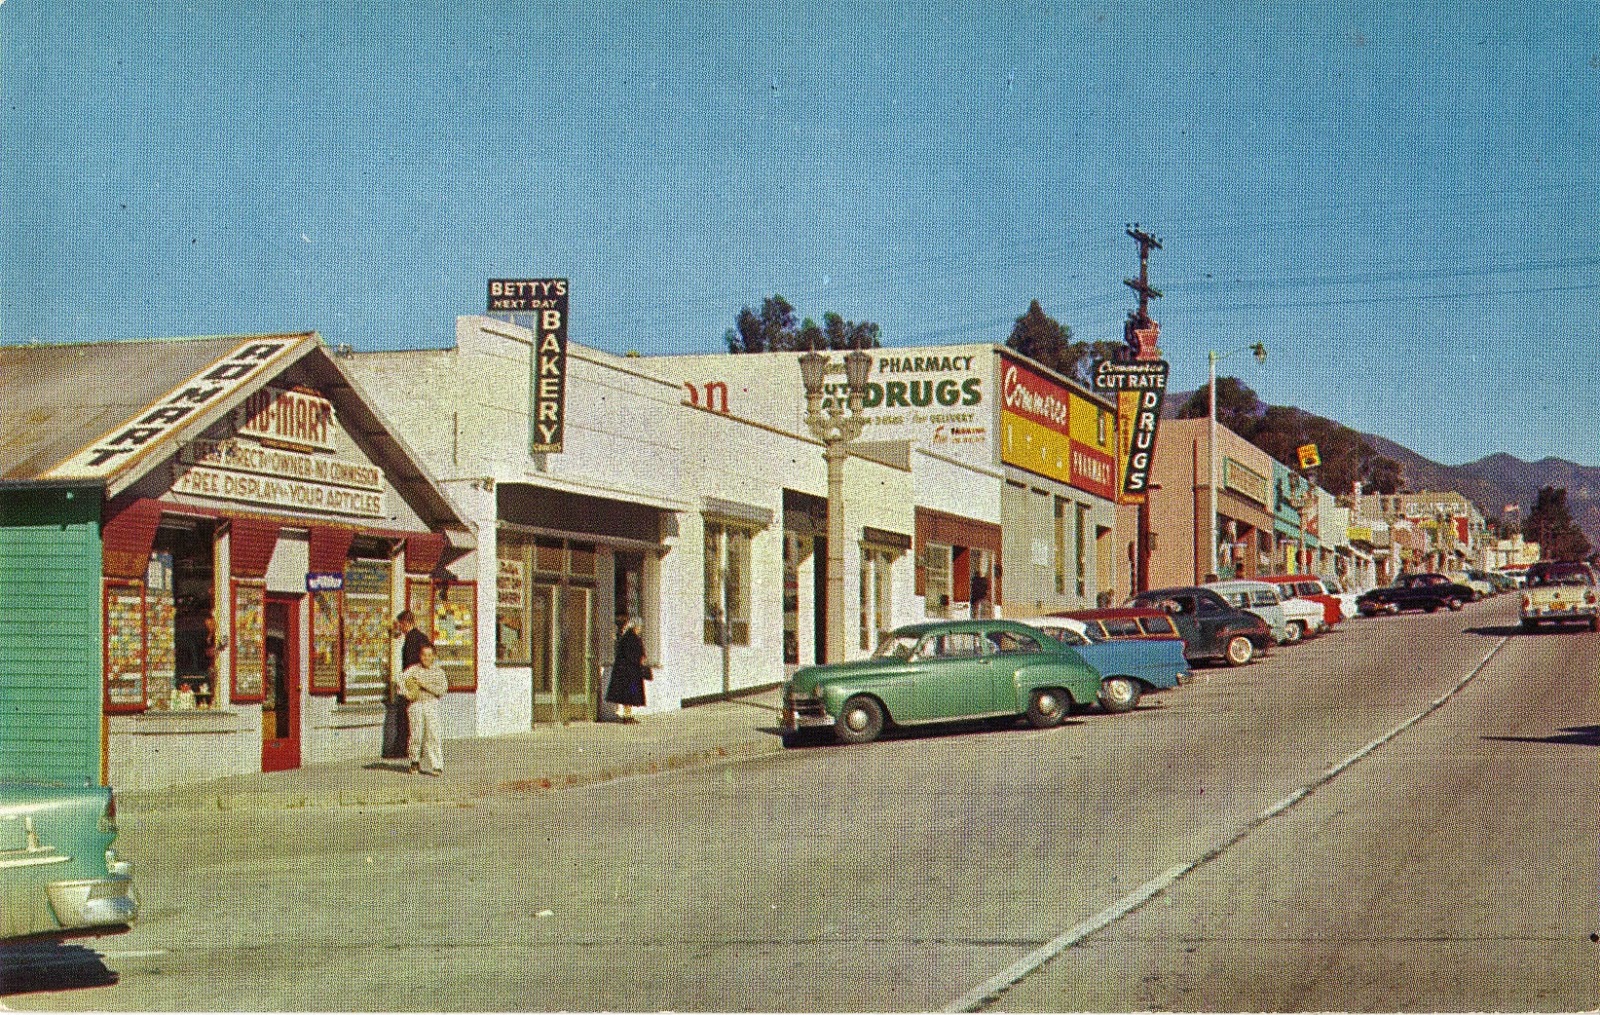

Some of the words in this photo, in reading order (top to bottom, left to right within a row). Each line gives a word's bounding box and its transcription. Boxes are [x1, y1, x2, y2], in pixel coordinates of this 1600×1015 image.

[491, 281, 567, 296] BETTY'S
[537, 310, 561, 444] BAKERY
[879, 356, 975, 373] PHARMACY
[862, 378, 982, 408] DRUGS
[1096, 374, 1126, 388] CUT
[1128, 373, 1166, 388] RATE
[1131, 392, 1158, 491] DRUGS
[182, 469, 220, 493] FREE
[225, 475, 278, 500] DISPLAY
[288, 484, 323, 505] YOUR
[327, 489, 381, 515] ARTICLES
